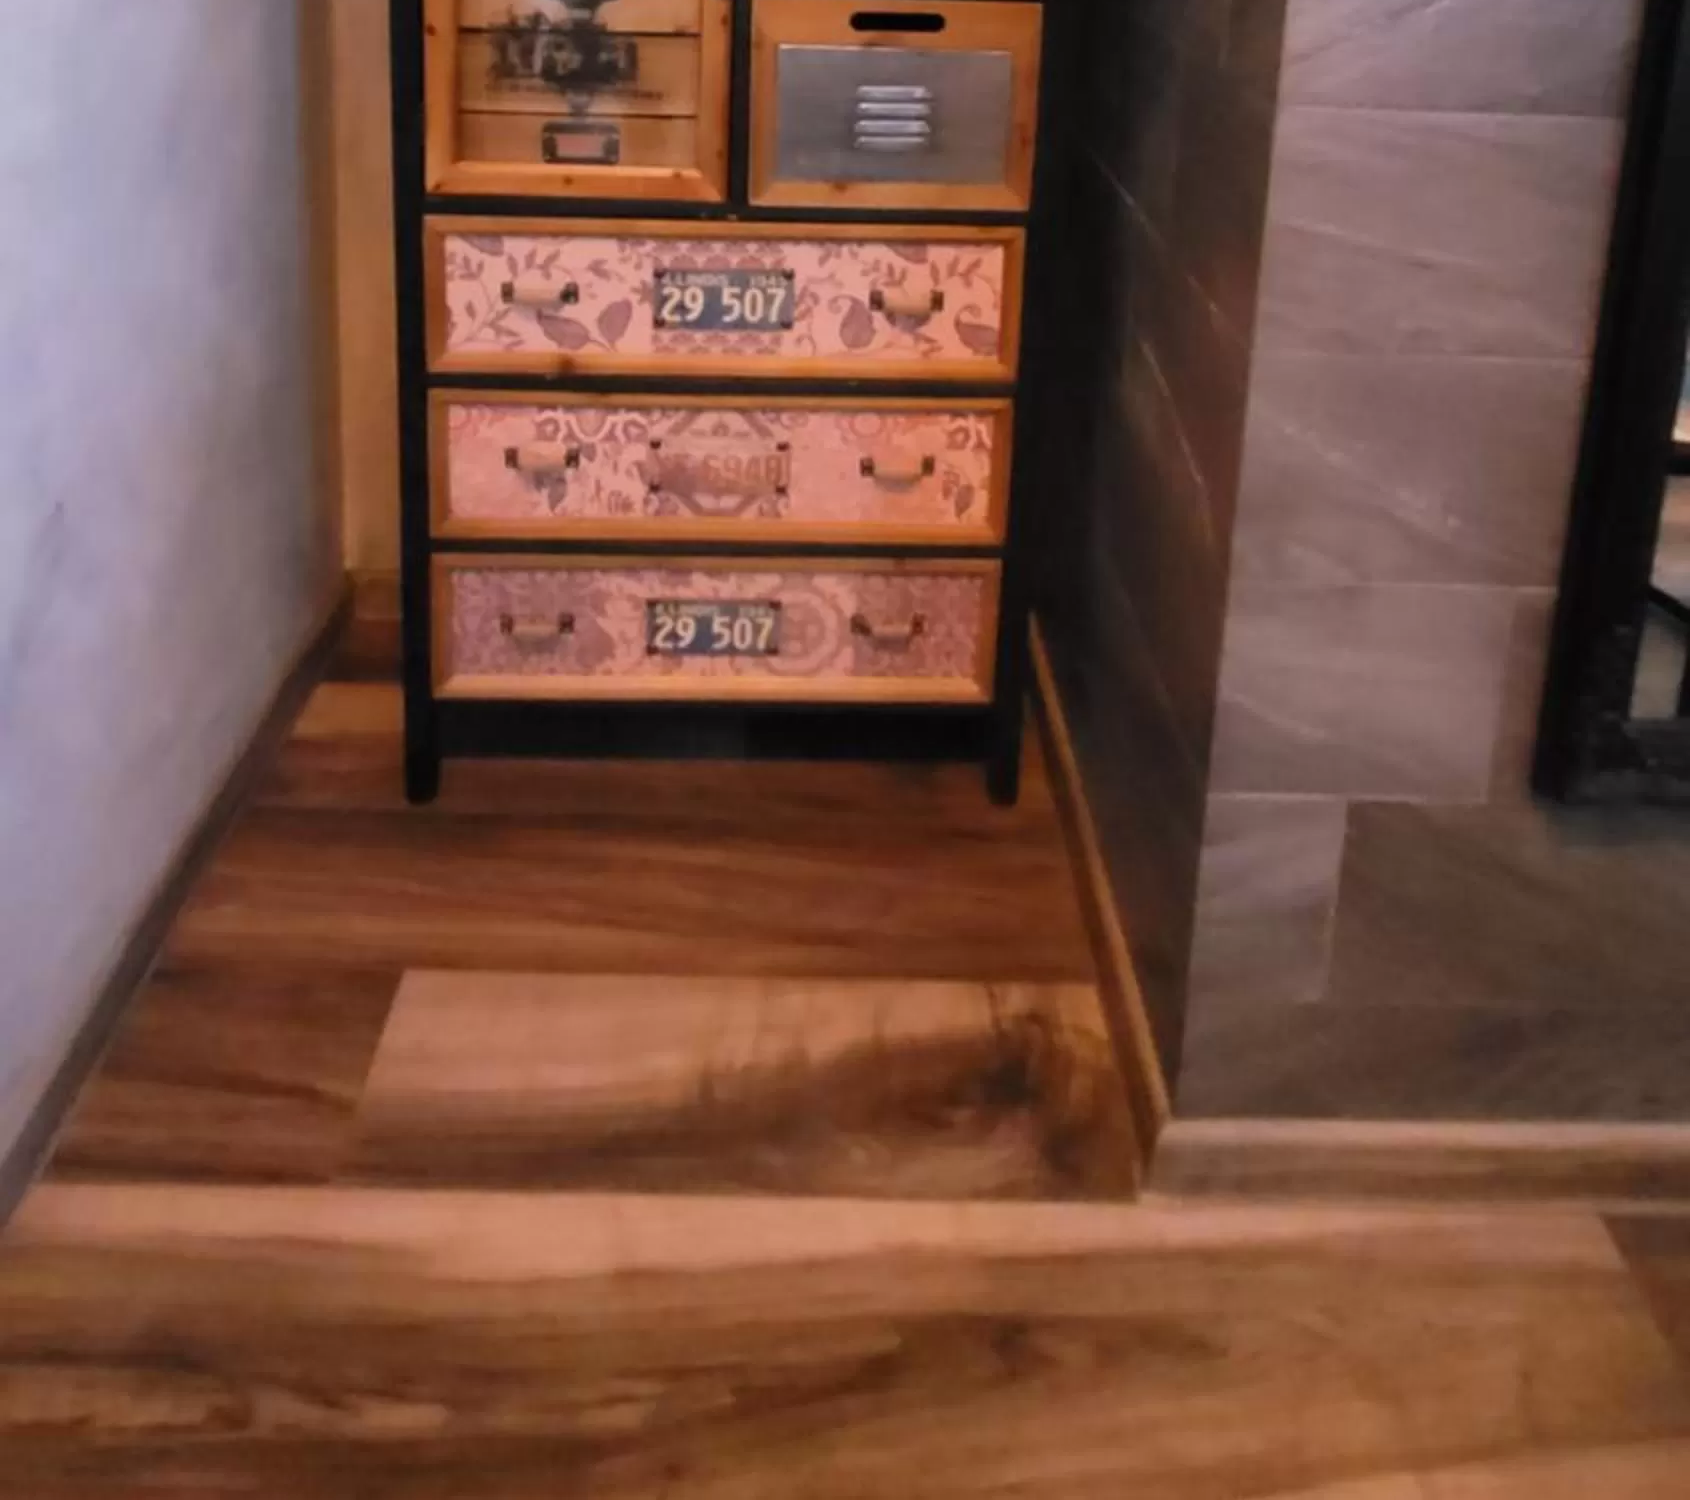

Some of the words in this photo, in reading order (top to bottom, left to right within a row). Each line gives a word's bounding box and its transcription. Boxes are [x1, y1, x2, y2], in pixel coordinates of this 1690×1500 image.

[660, 286, 705, 323] 29
[721, 286, 786, 324] 507
[654, 615, 696, 649] 29
[711, 615, 774, 651] 507
